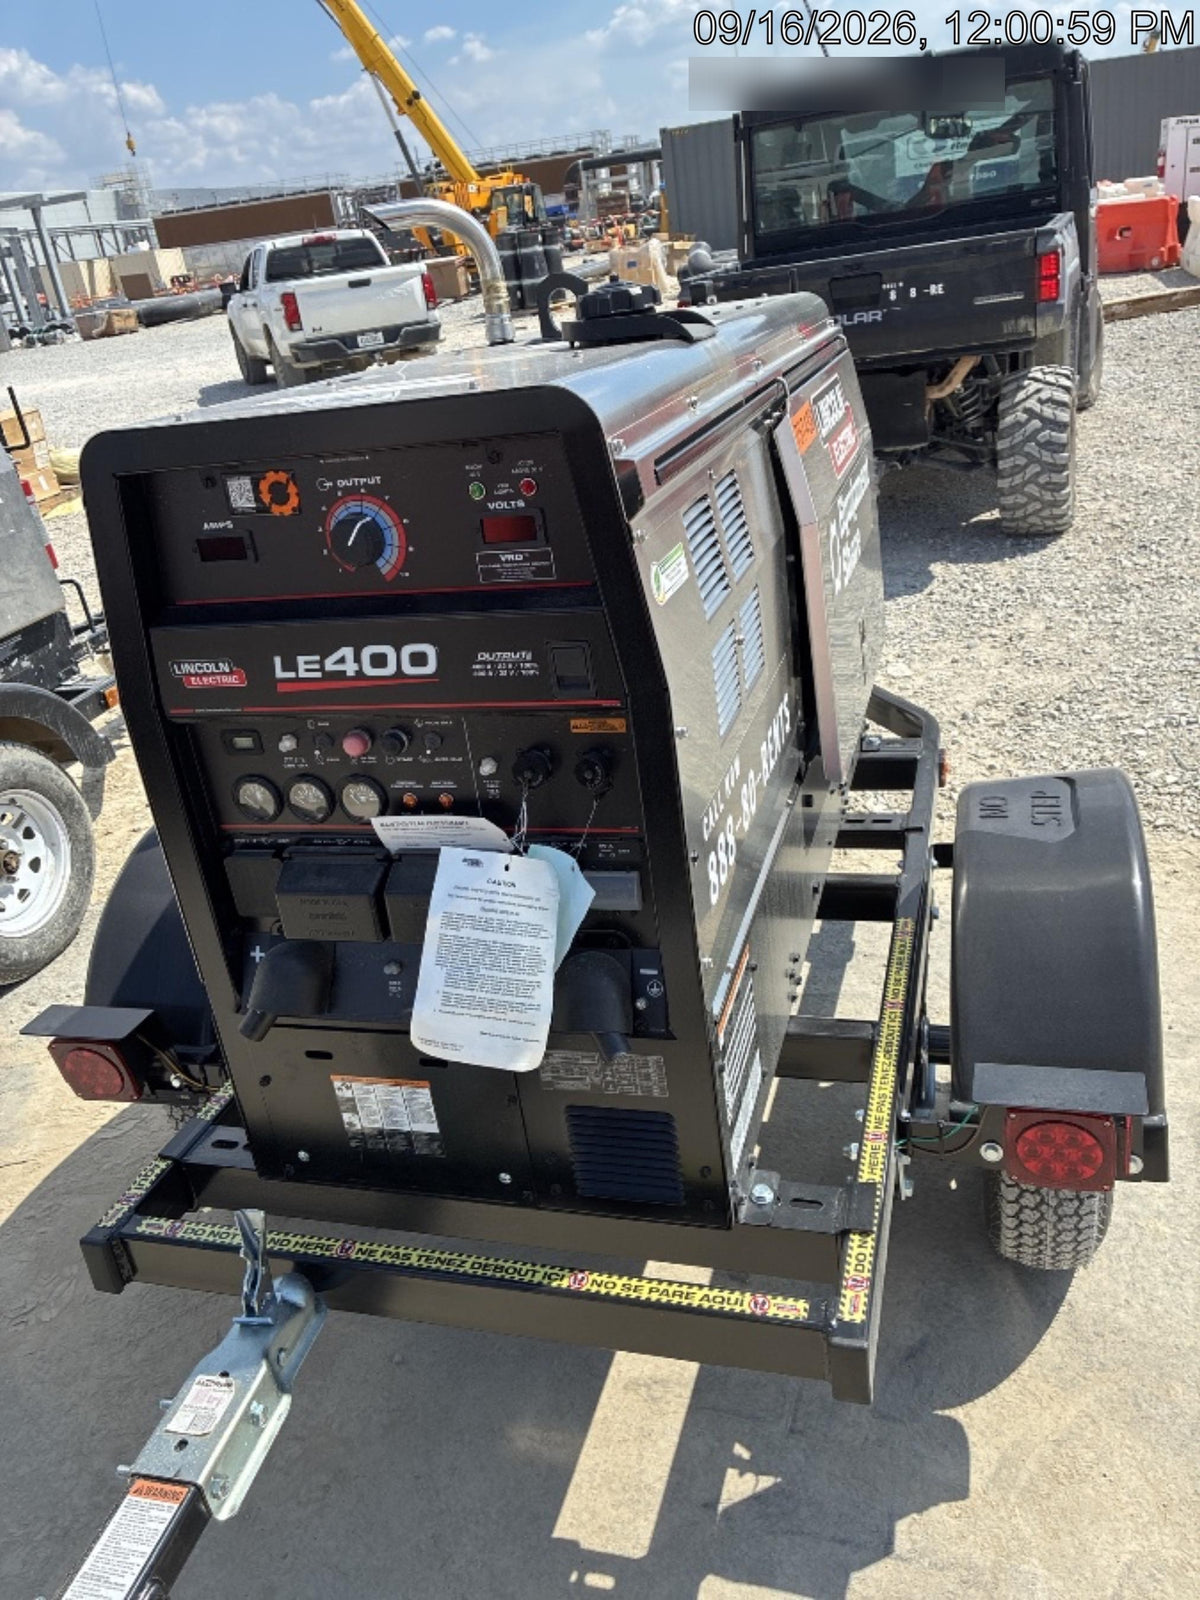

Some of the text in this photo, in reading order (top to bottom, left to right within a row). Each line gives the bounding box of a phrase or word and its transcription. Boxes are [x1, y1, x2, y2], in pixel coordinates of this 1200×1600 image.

[337, 475, 382, 488] OUTPUT
[487, 499, 526, 511] VOLTS
[173, 661, 231, 675] LINCOLN
[273, 643, 438, 679] LE400
[190, 675, 239, 686] ELECTRIC
[707, 692, 792, 907] 888-80-RENTS
[701, 790, 725, 842] CALL
[183, 1226, 240, 1241] DO NOT
[293, 1240, 336, 1254] HERE
[354, 1246, 567, 1282] NE PAS TENEZ DEBOUT ICI
[853, 1252, 868, 1274] DO
[591, 1278, 745, 1308] NO SE PARE AQUI
